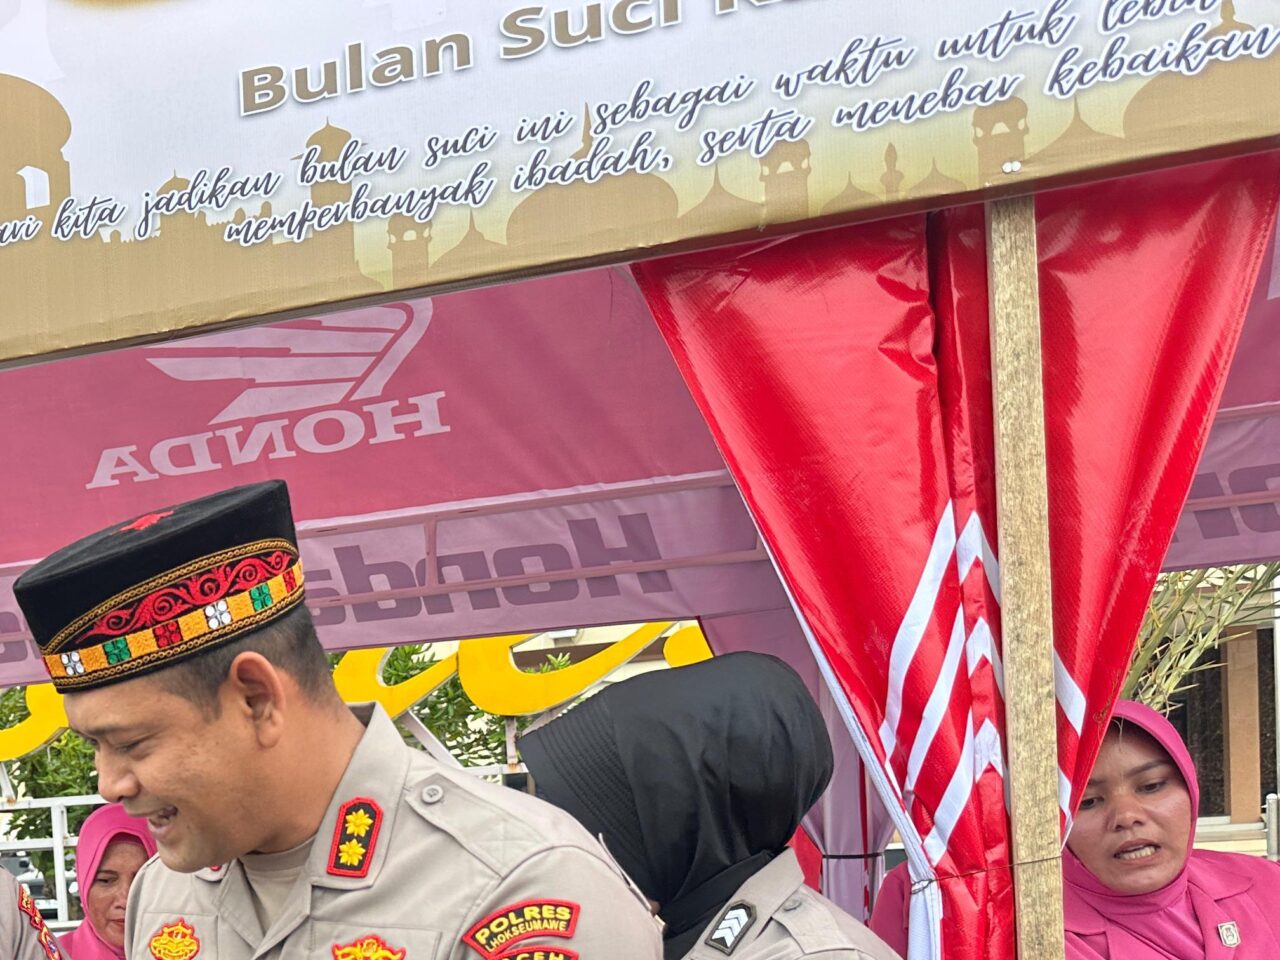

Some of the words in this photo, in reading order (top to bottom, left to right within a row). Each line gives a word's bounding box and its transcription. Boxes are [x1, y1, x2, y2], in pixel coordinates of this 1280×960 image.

[241, 33, 472, 114] Bulan
[499, 0, 681, 57] Suci
[52, 193, 123, 238] kita
[137, 168, 282, 237] jadikan
[299, 143, 408, 187] bulan
[426, 127, 498, 169] suci
[518, 110, 574, 146] ini
[594, 74, 754, 130] sebagai
[775, 37, 916, 98] waktu
[937, 10, 1076, 60] untuk
[224, 164, 495, 245] memperbanyak
[513, 135, 672, 188] ibadah,
[699, 106, 812, 167] serta
[834, 65, 1021, 131] menebar
[1047, 22, 1280, 96] kebaikan
[475, 904, 571, 945] POLRES
[485, 919, 567, 953] LHOKSEUMAWE
